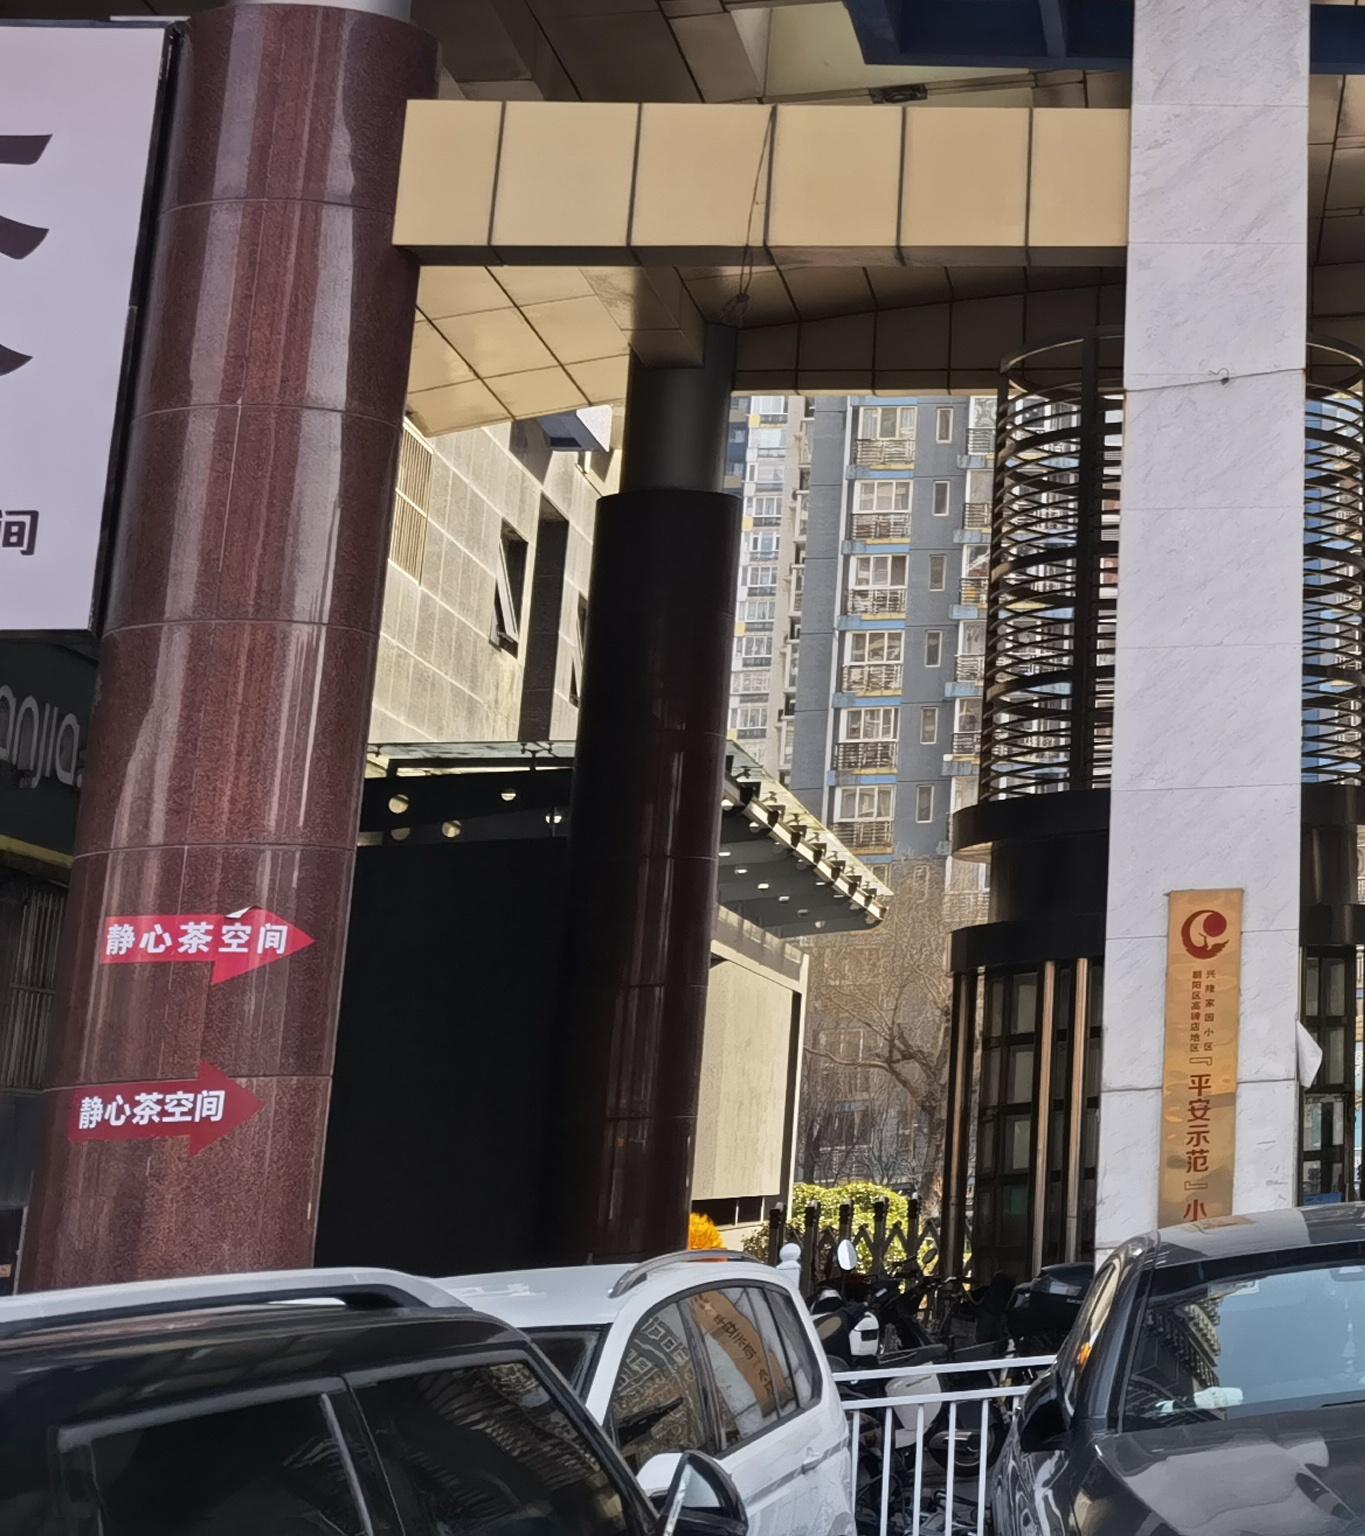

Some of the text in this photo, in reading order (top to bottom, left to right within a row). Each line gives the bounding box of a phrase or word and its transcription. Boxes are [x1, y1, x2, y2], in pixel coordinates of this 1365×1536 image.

[106, 922, 288, 955] 静心茶空间
[1203, 970, 1216, 1051] 兴隆家园小区
[79, 1090, 226, 1129] 静心茶空间
